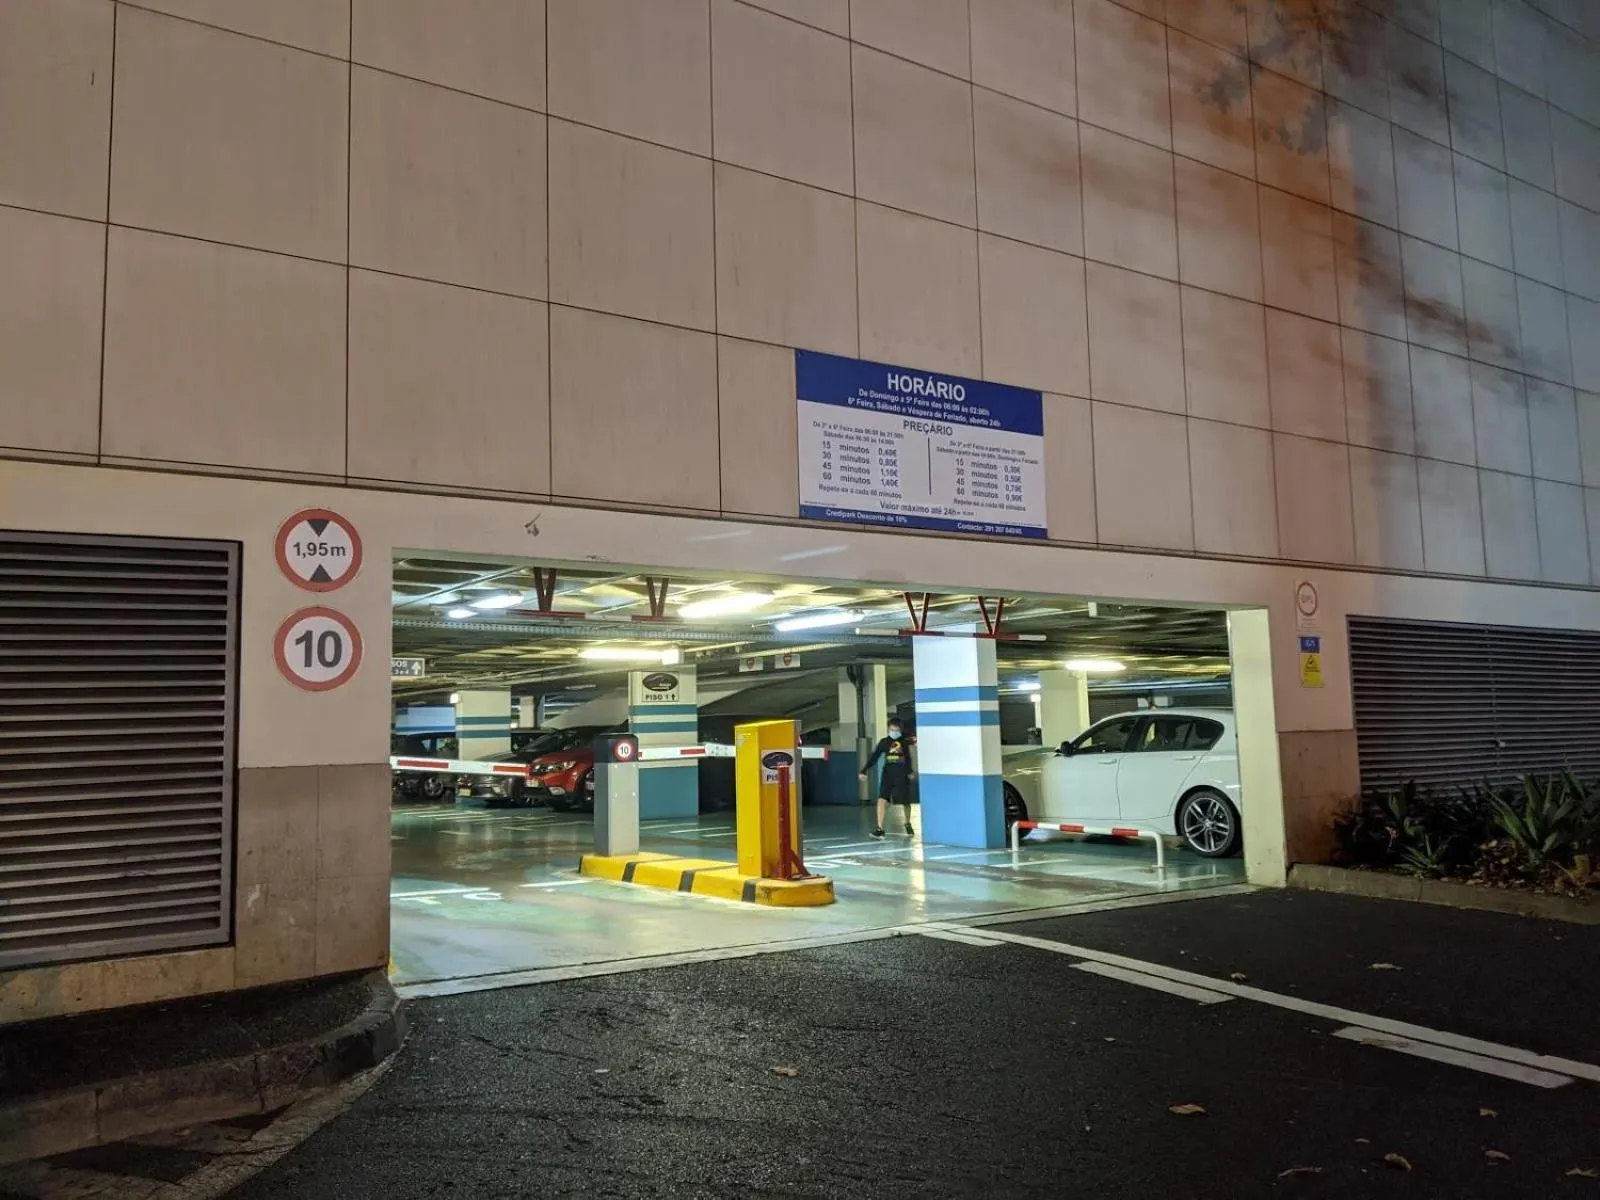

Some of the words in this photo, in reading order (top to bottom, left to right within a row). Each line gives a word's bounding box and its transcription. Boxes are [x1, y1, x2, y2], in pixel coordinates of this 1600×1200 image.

[887, 372, 966, 402] HORÁRIO
[869, 390, 899, 403] Domingo
[822, 440, 831, 449] 15
[840, 444, 870, 454] minutos
[822, 451, 831, 460] 30
[840, 454, 870, 464] minutos
[822, 462, 832, 470] 45
[840, 465, 870, 475] minutos
[971, 461, 998, 470] minutos
[822, 471, 832, 480] 60
[840, 475, 871, 485] minutos
[956, 468, 964, 476] 30
[971, 471, 998, 480] minutos
[956, 478, 965, 486] 45
[972, 480, 998, 489] minutos
[878, 490, 902, 499] minutos
[972, 490, 999, 499] minutos
[880, 501, 899, 510] Valor
[900, 504, 930, 514] máximo
[293, 542, 346, 560] 1,95m
[295, 630, 343, 668] 10
[620, 746, 629, 754] 10
